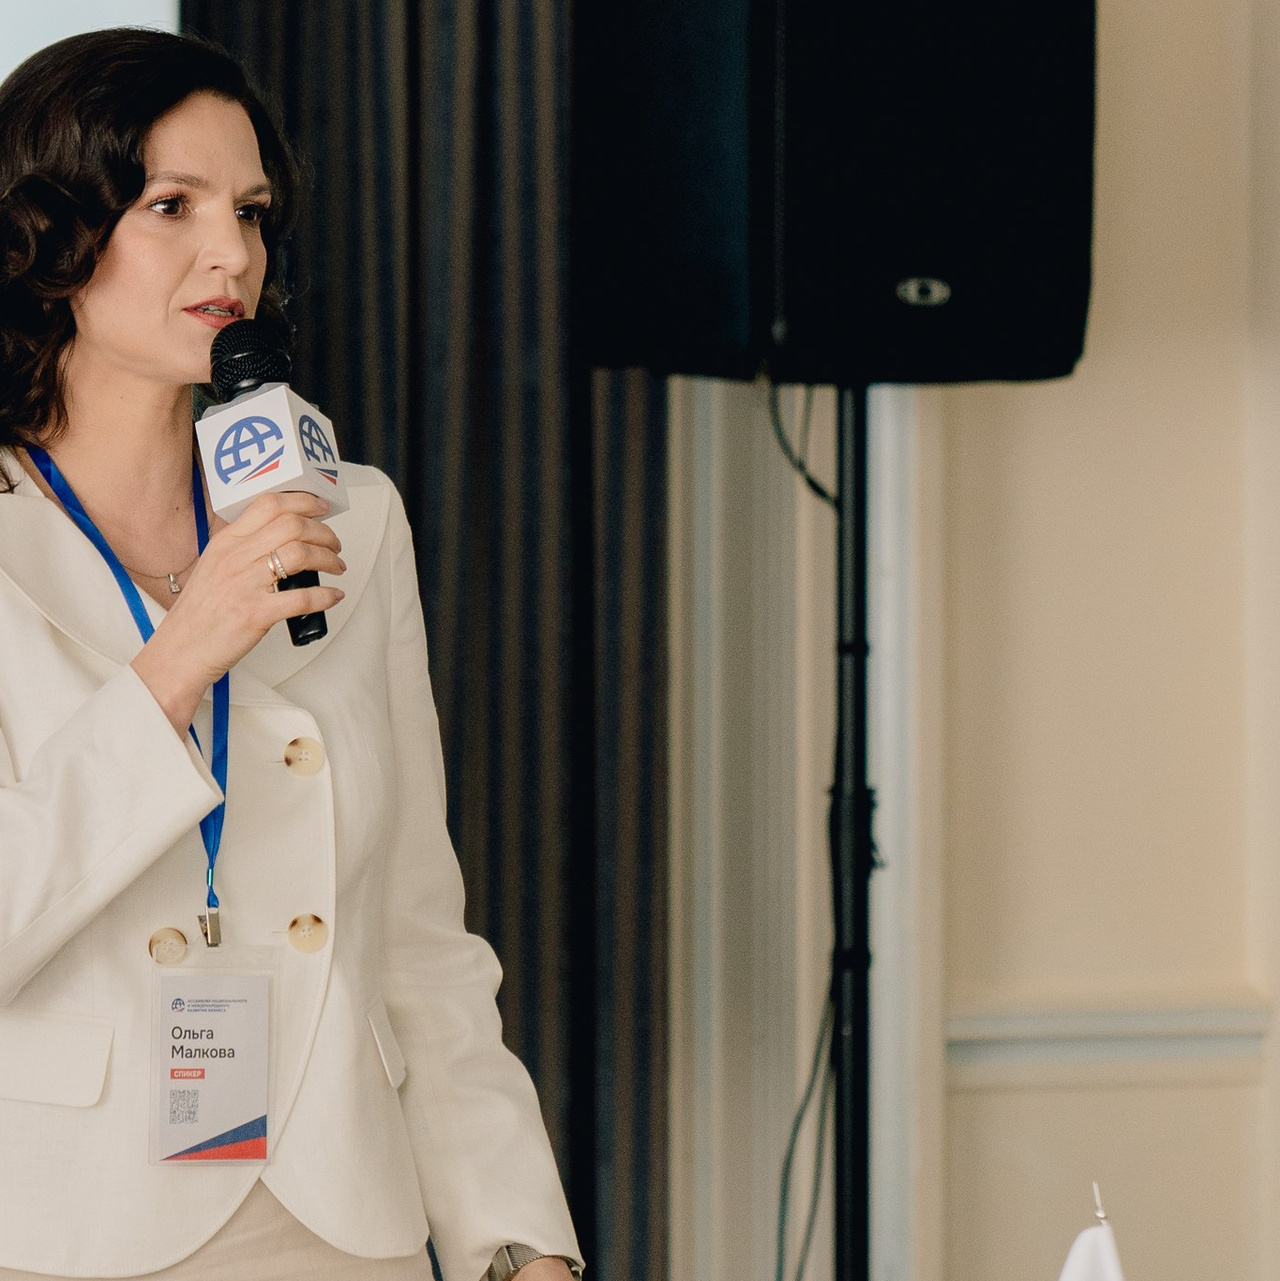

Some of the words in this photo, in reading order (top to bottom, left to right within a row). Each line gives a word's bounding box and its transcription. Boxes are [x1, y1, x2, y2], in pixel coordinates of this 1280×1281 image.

[171, 1026, 214, 1040] Ольга
[171, 1045, 235, 1059] Малкова
[173, 1070, 202, 1078] СПИКЕР
